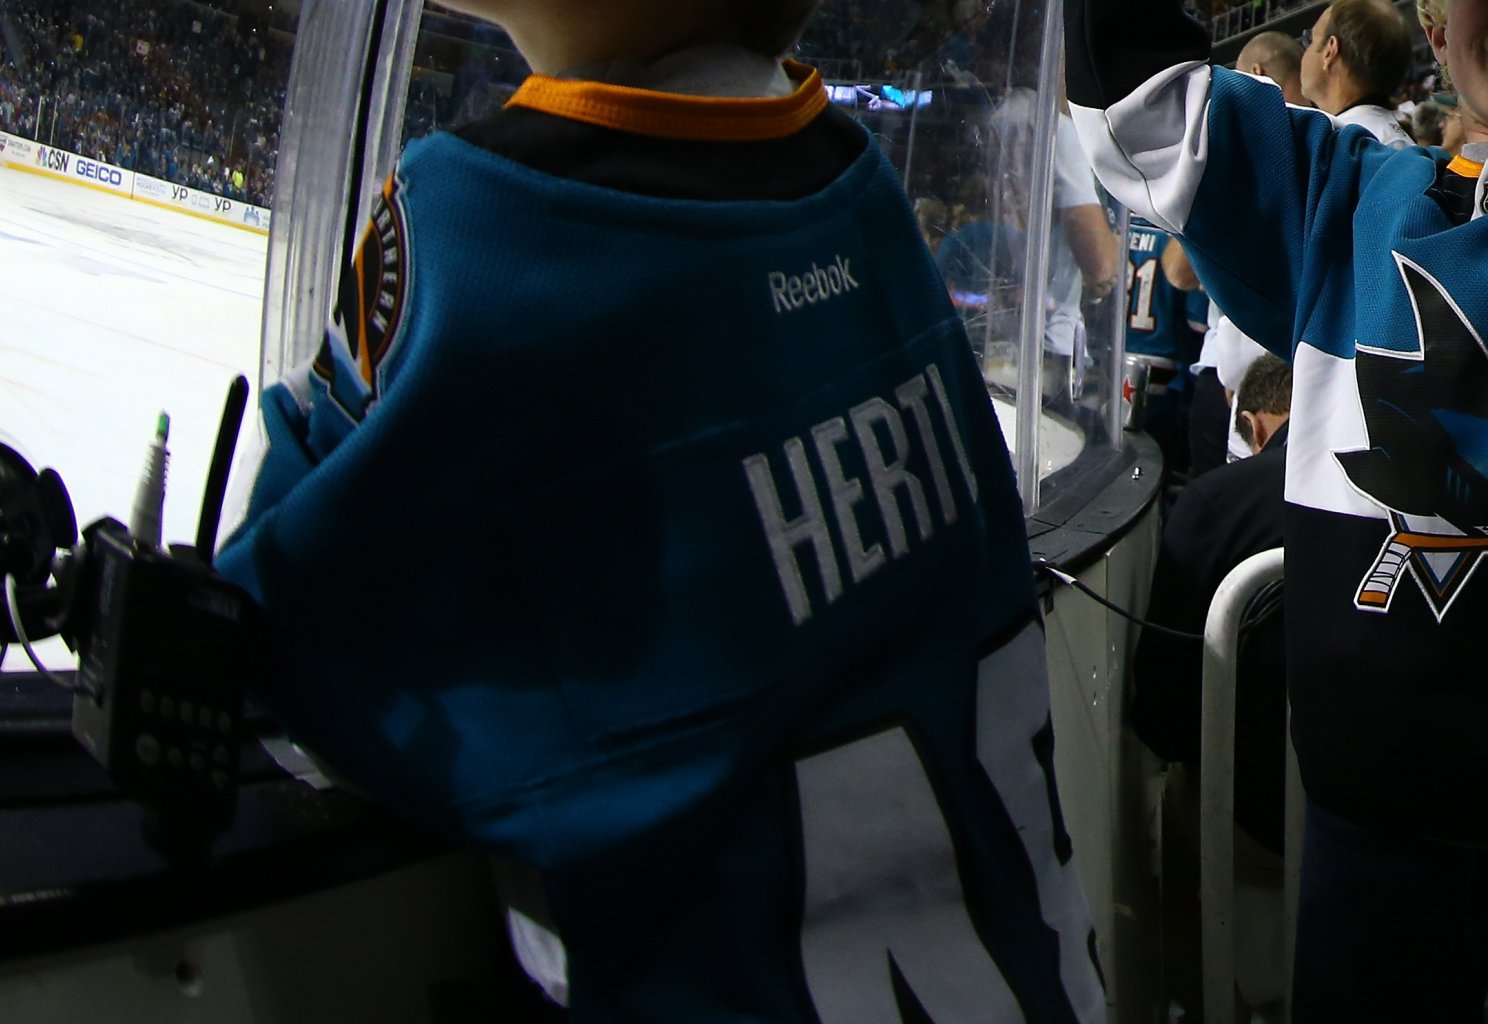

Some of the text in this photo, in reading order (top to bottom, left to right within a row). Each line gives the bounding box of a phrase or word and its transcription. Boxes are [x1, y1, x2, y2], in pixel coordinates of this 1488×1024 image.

[48, 149, 70, 173] CSN
[76, 159, 122, 186] GEICO
[172, 185, 188, 201] yp
[214, 197, 231, 212] yp
[769, 255, 860, 314] Reebok
